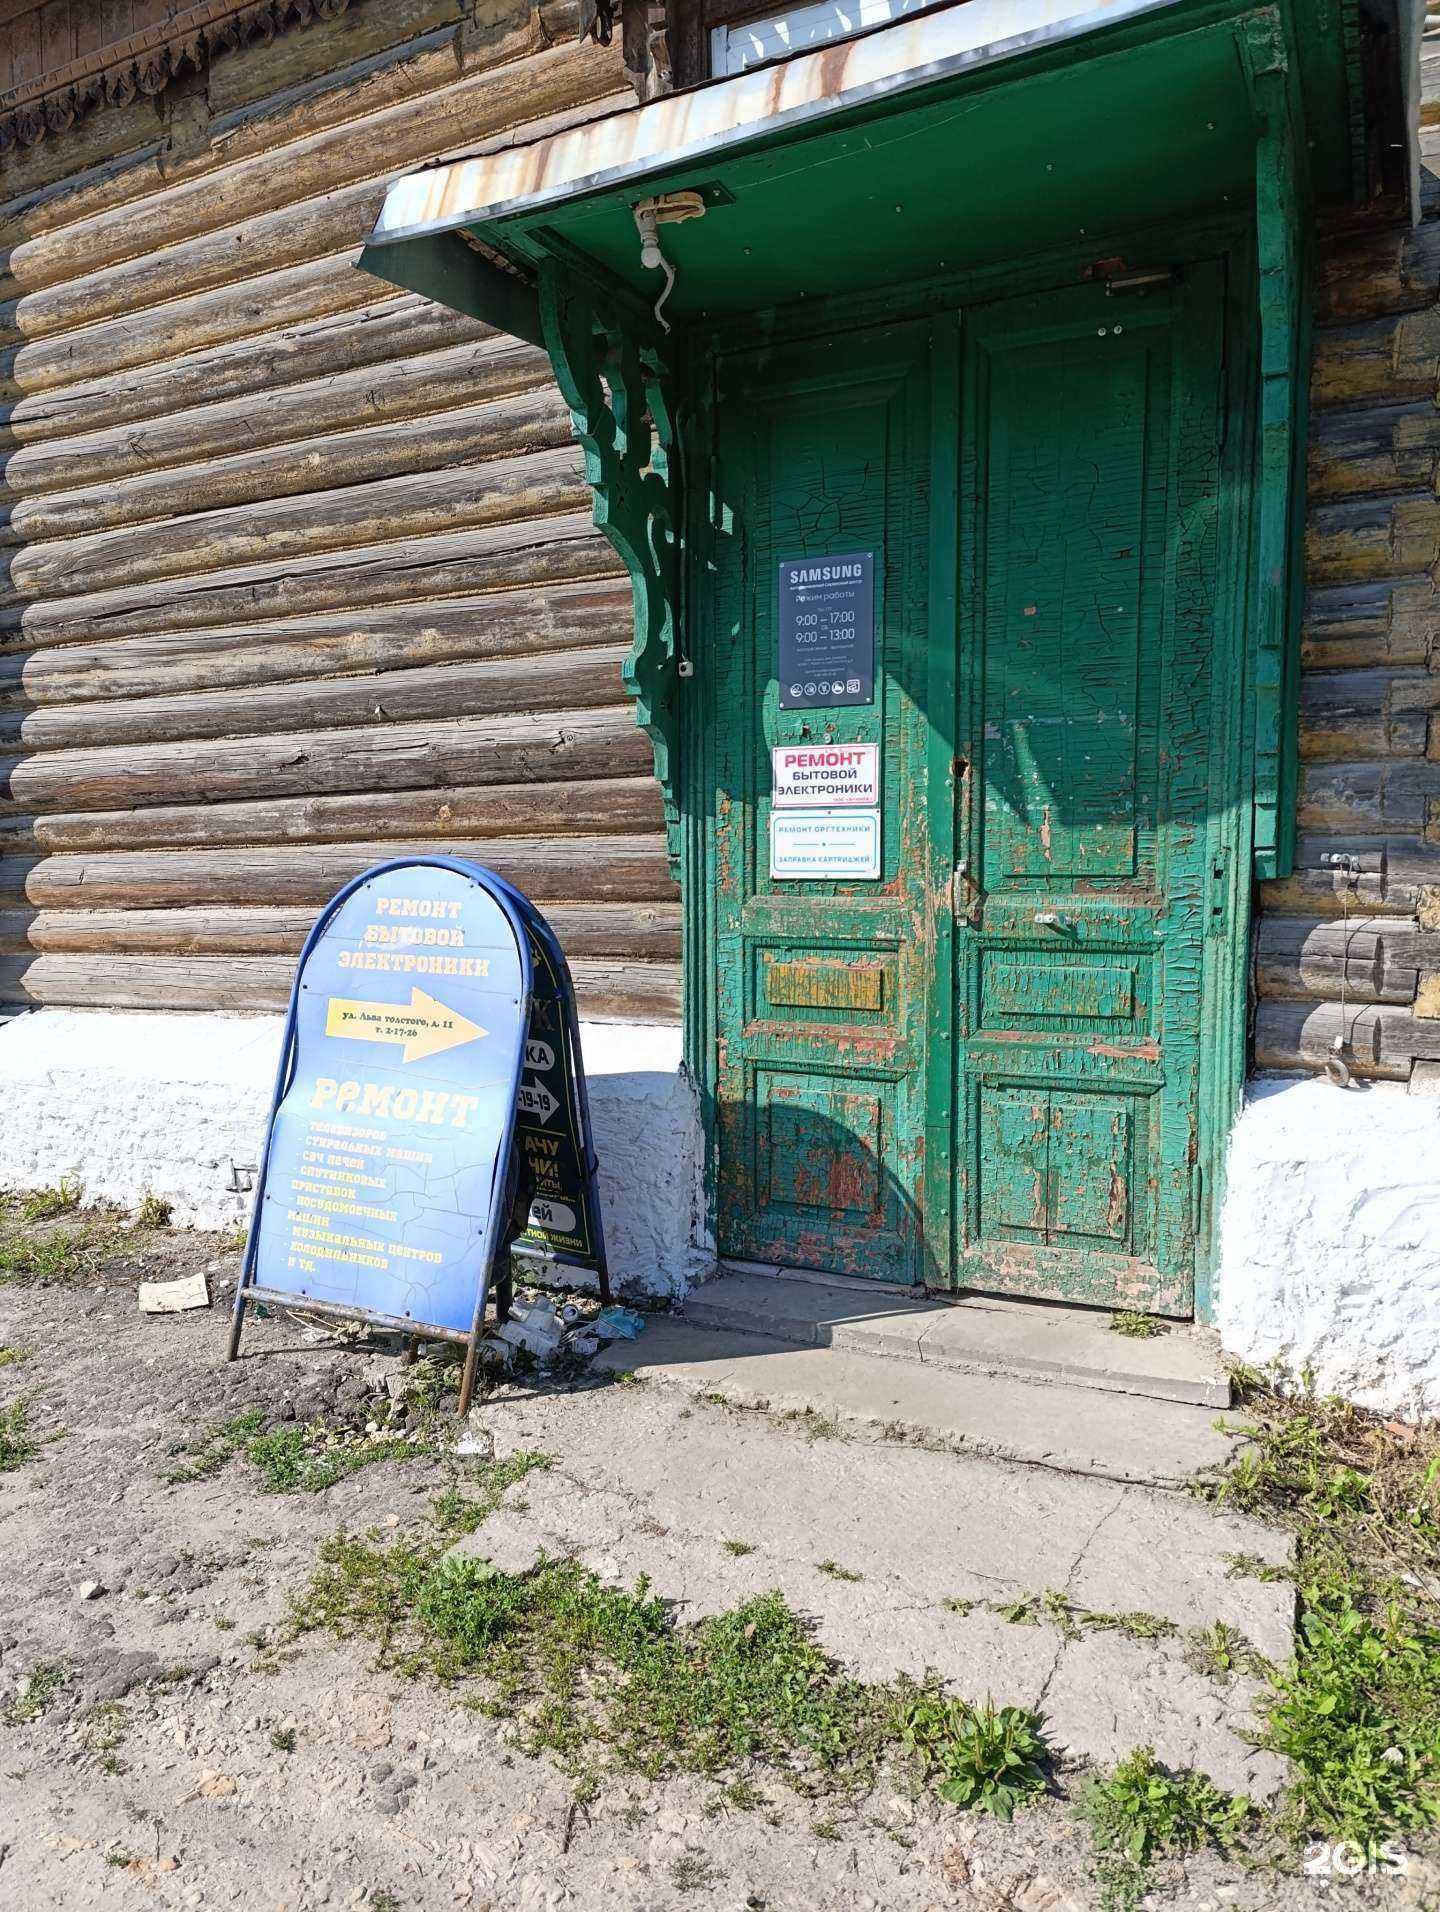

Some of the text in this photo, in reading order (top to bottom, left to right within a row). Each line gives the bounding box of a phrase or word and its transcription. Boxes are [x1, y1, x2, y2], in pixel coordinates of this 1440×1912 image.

[790, 564, 862, 584] SAMSUNG
[795, 614, 818, 627] 9:00
[829, 610, 855, 624] 17:00
[795, 631, 818, 643] 9:00
[829, 628, 855, 640] 13:00
[785, 752, 866, 767] РЕМОНТ
[792, 768, 858, 781] БЫТОВОЙ
[778, 783, 873, 795] ЭЛЕКТРОНИКИ
[815, 825, 870, 833] ОРГТЕХНИКИ
[818, 855, 870, 863] КАРТРИДЖЕЙ
[376, 898, 463, 919] РЕМОНТ
[363, 923, 466, 947] БЫТОВОЙ
[338, 952, 490, 977] ЭЛЕКТРОНИКИ
[442, 1020, 454, 1029] 11
[302, 1149, 325, 1163] СВЧ
